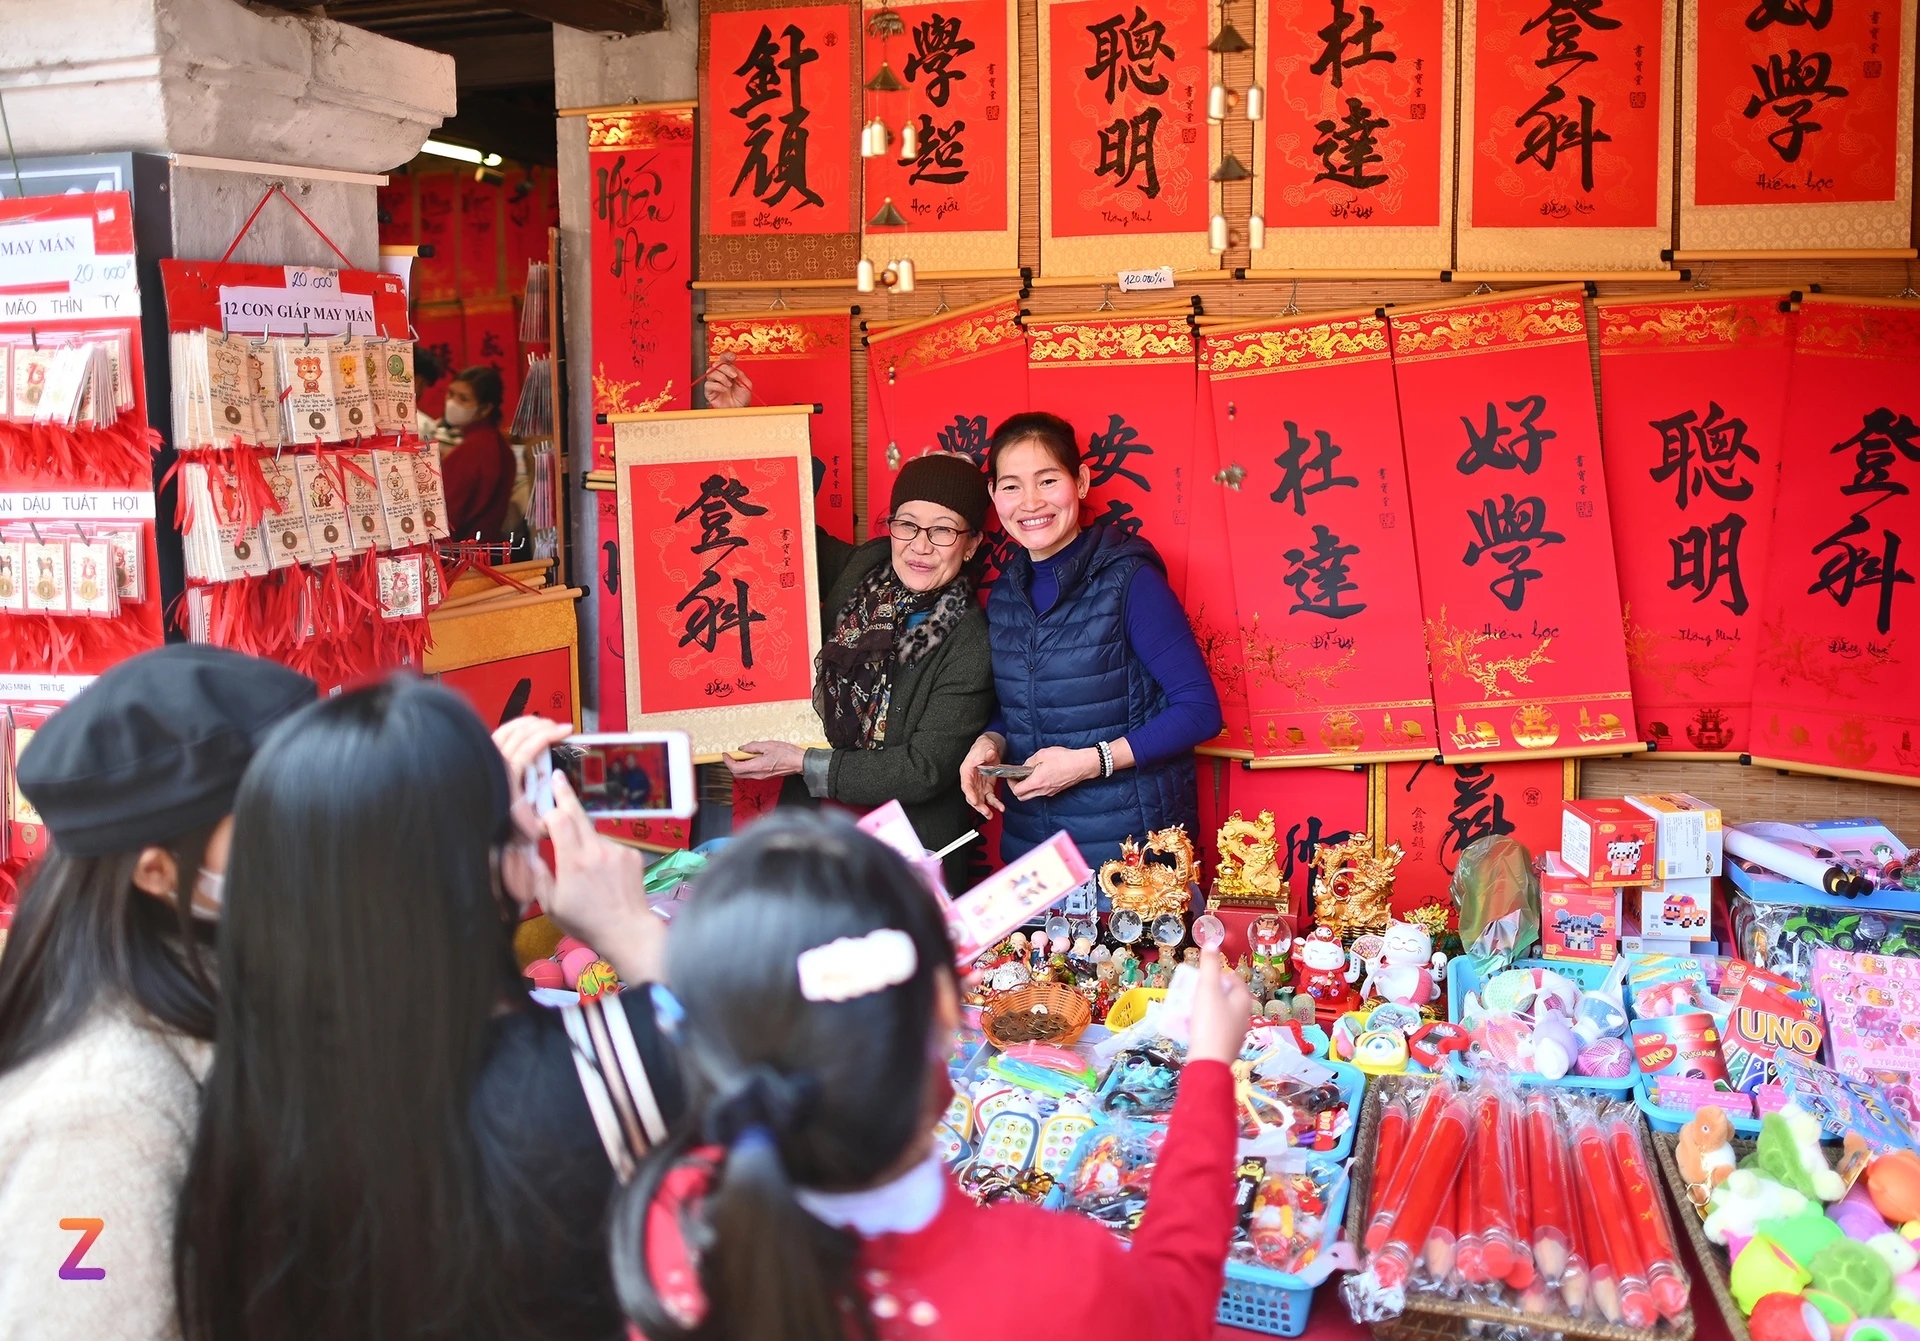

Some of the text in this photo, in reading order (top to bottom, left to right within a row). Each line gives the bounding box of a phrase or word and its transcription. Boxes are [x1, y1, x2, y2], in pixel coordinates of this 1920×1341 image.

[1085, 6, 1175, 199] 聰明
[1310, 0, 1397, 189] 杜達
[1, 240, 35, 256] MAY
[5, 298, 37, 316] MÃO
[51, 298, 83, 314] THÌN
[223, 301, 238, 317] 12
[241, 302, 274, 318] CON
[277, 301, 311, 319] GIÁP
[314, 306, 341, 321] MAY
[675, 474, 768, 669] 登科
[1270, 421, 1367, 619] 杜達
[1457, 395, 1566, 611] 好學
[1649, 401, 1760, 616] 聰明
[1808, 407, 1920, 635] 登科
[1638, 1033, 1663, 1045] UNO
[1641, 1047, 1673, 1067] UNO
[1738, 1007, 1823, 1055] UNO
